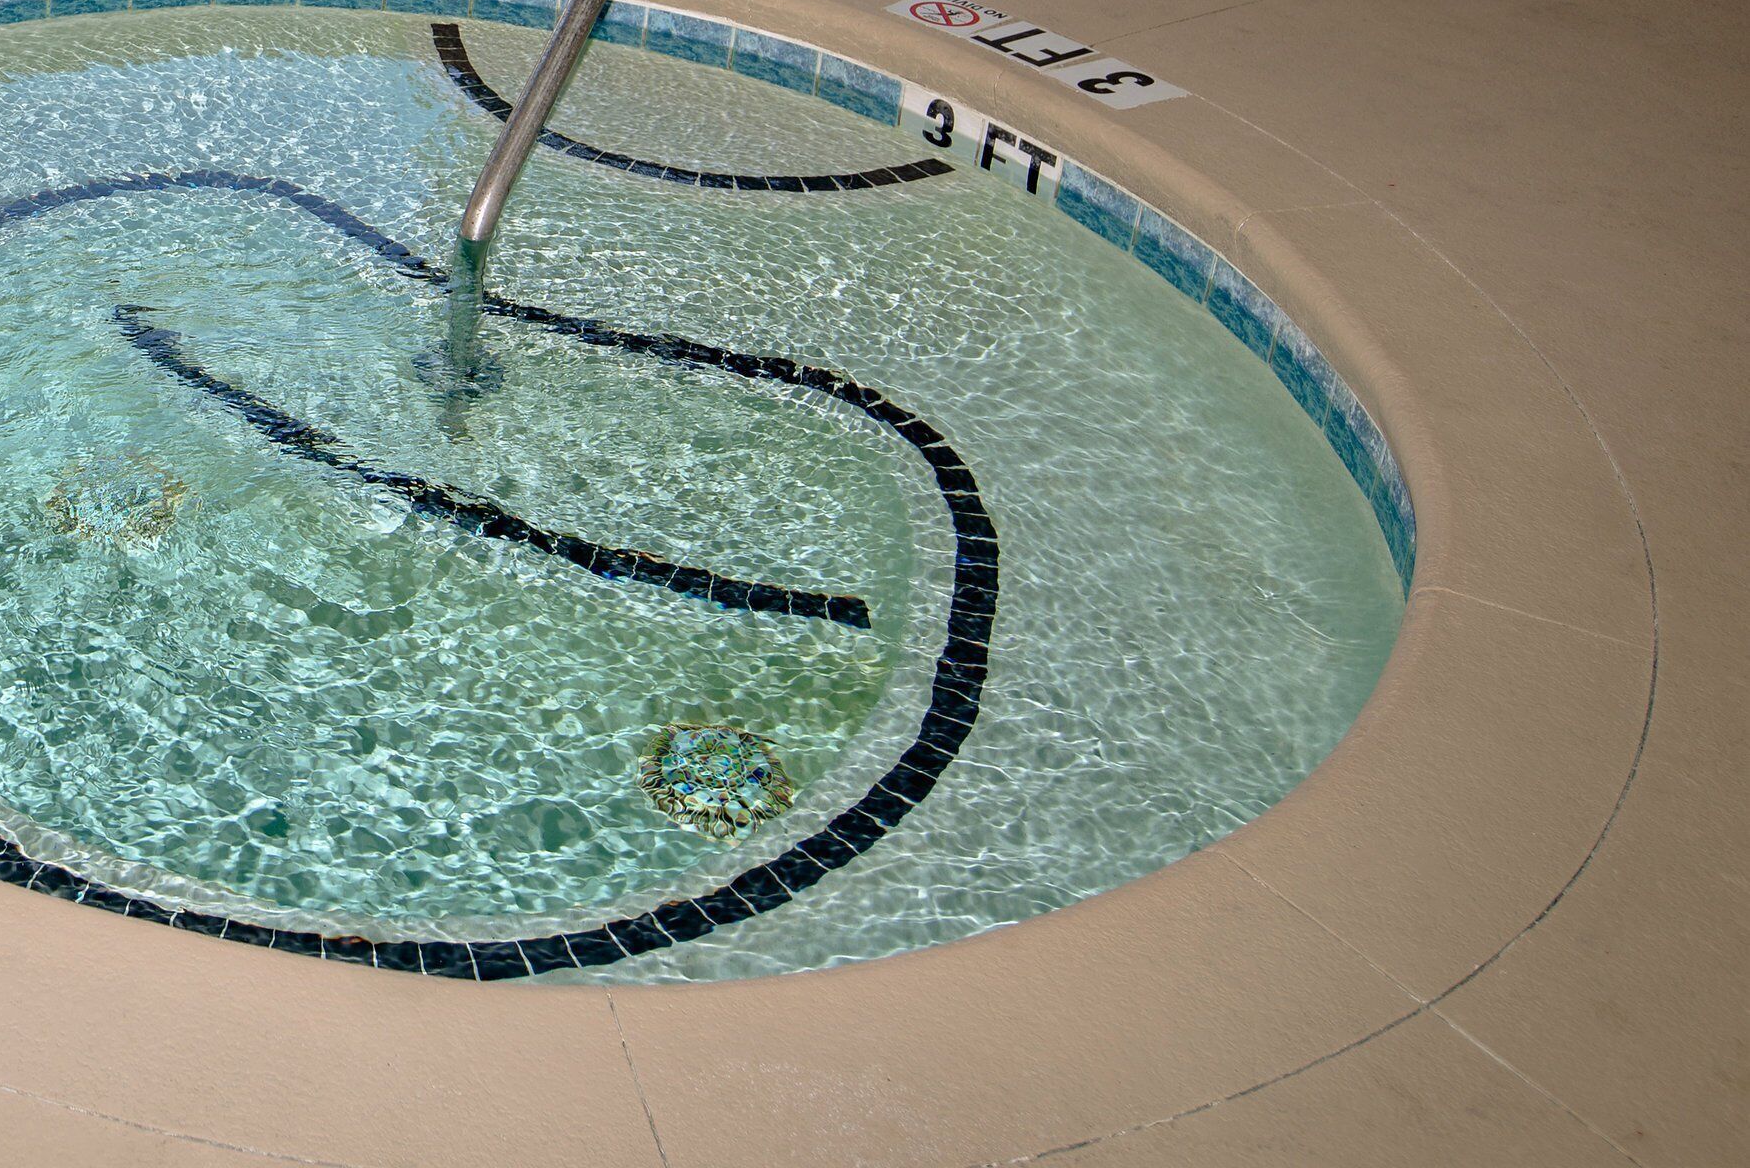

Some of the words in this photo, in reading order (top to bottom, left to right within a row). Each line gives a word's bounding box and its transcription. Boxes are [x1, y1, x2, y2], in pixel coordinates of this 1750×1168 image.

[984, 9, 1008, 20] NO
[969, 28, 1094, 68] FT
[1077, 71, 1155, 94] 3
[922, 98, 955, 148] 3
[980, 121, 1058, 195] FT
